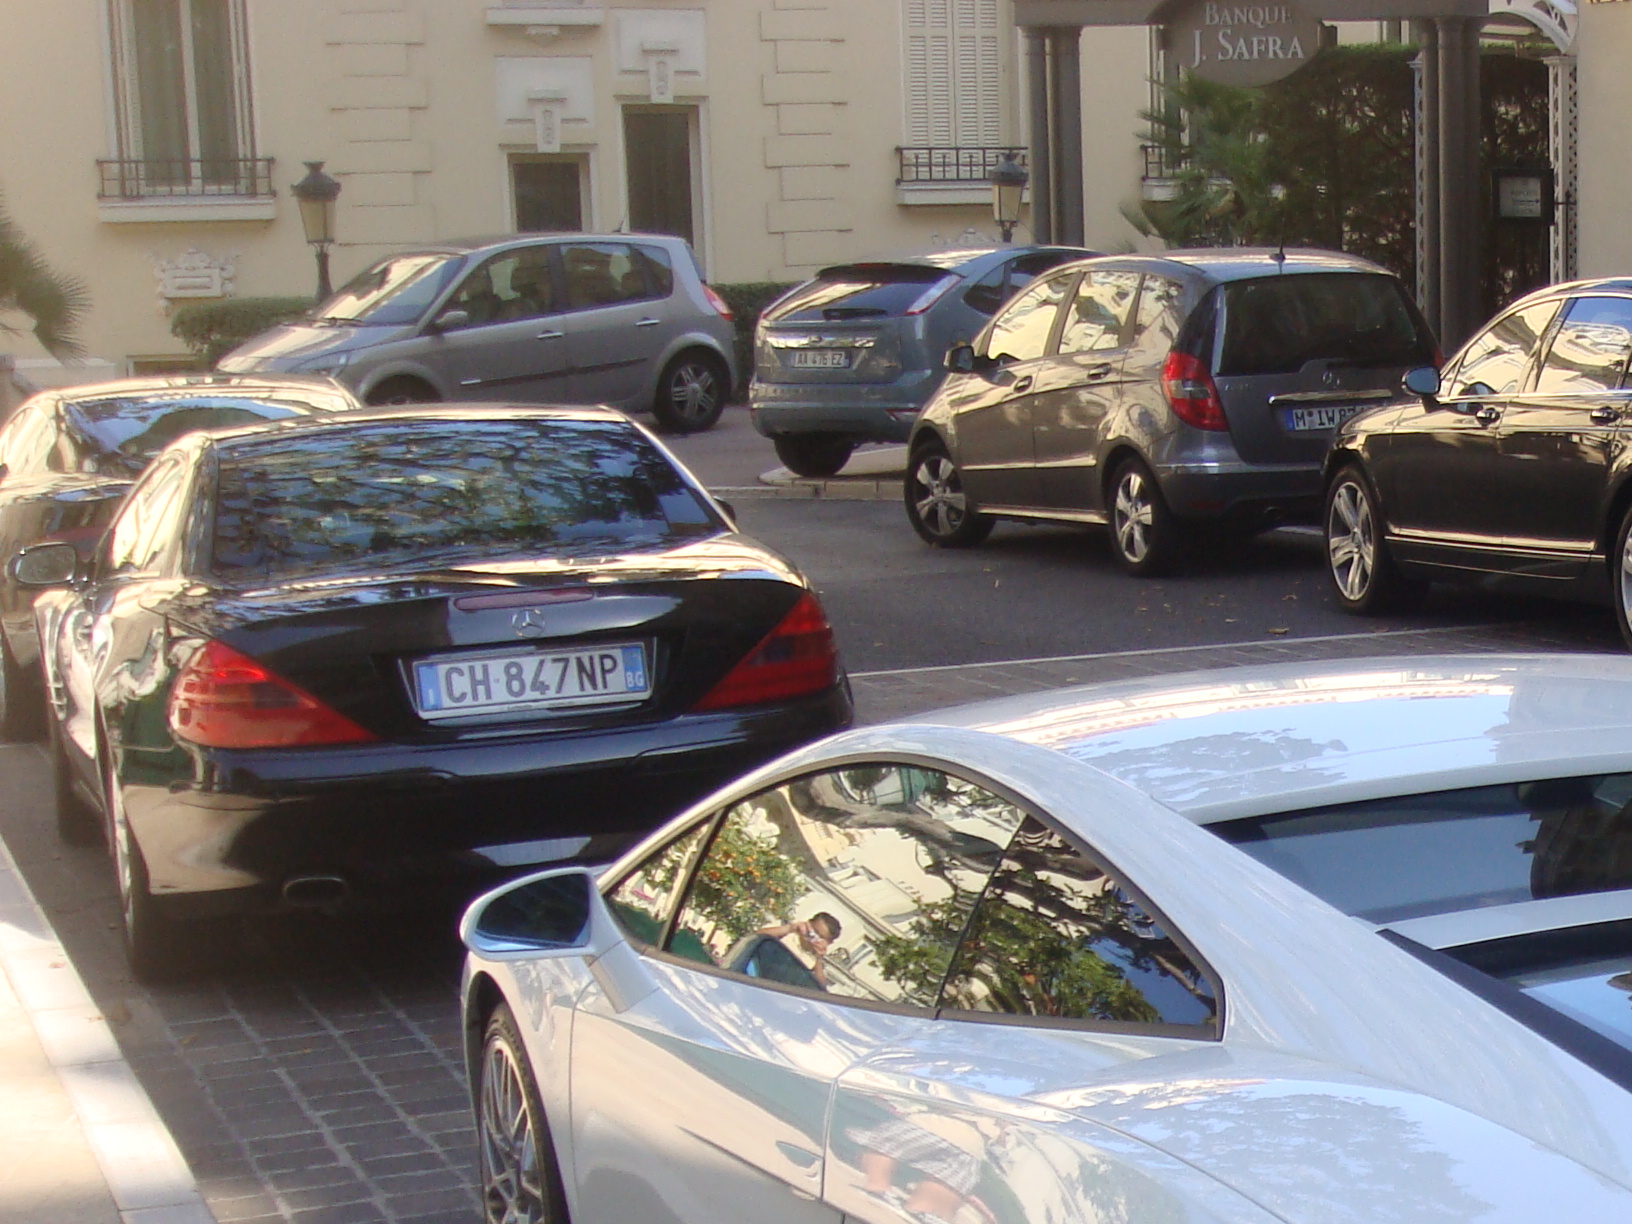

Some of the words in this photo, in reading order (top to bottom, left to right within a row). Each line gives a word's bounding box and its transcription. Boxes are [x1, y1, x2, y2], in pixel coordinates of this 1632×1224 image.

[1204, 1, 1293, 29] BANQUE
[1191, 29, 1207, 68] J.
[1217, 29, 1305, 61] SAFRA
[444, 663, 493, 704] CH
[626, 669, 645, 688] BG
